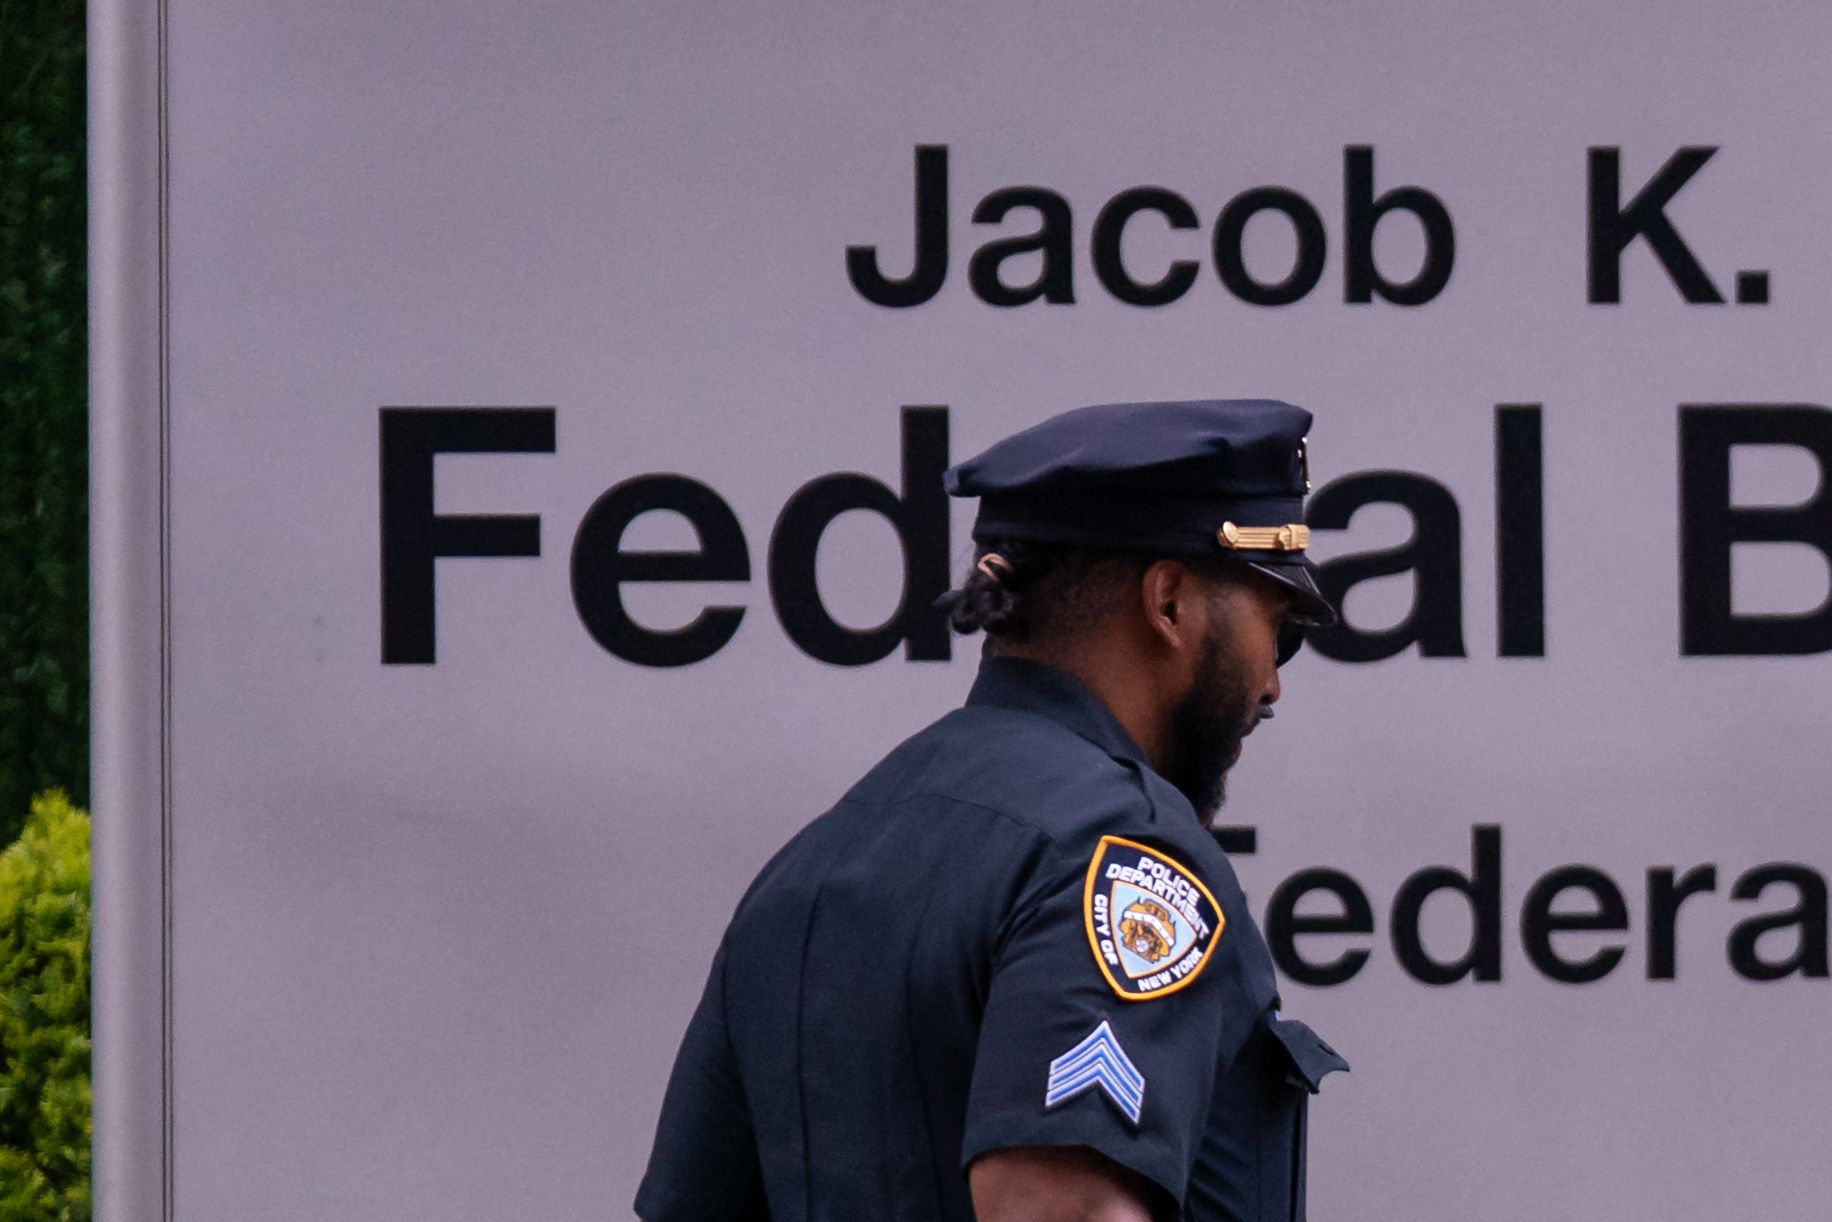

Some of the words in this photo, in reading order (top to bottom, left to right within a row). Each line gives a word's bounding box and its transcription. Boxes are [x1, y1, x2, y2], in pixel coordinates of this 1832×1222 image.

[845, 143, 1456, 308] Jacob
[1586, 145, 1770, 305] K.
[379, 404, 1546, 668] Fedal
[1105, 863, 1209, 939] DEPARTMENT
[1138, 857, 1200, 906] POLICE
[1094, 894, 1110, 936] CITY
[1101, 940, 1118, 965] OF
[1138, 970, 1172, 992] NEW
[1170, 946, 1203, 979] YORK
